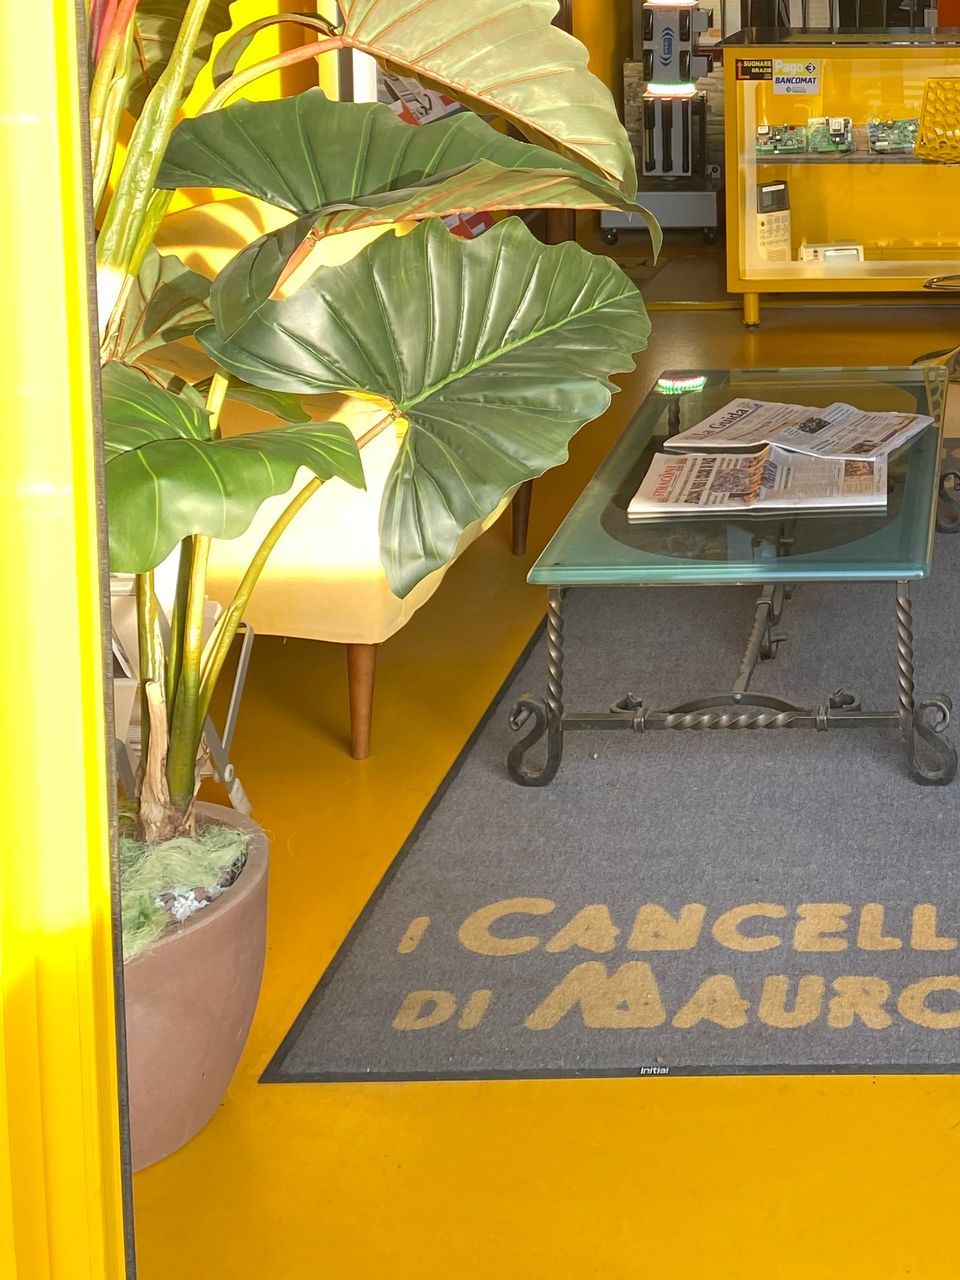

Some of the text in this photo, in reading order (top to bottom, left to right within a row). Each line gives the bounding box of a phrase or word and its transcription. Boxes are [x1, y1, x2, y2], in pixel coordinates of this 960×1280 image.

[774, 60, 803, 75] Pago
[775, 76, 817, 84] BANCOMAT
[708, 407, 750, 432] Guida
[398, 914, 431, 955] I
[391, 988, 494, 1031] DI
[640, 1066, 670, 1075] Initial
